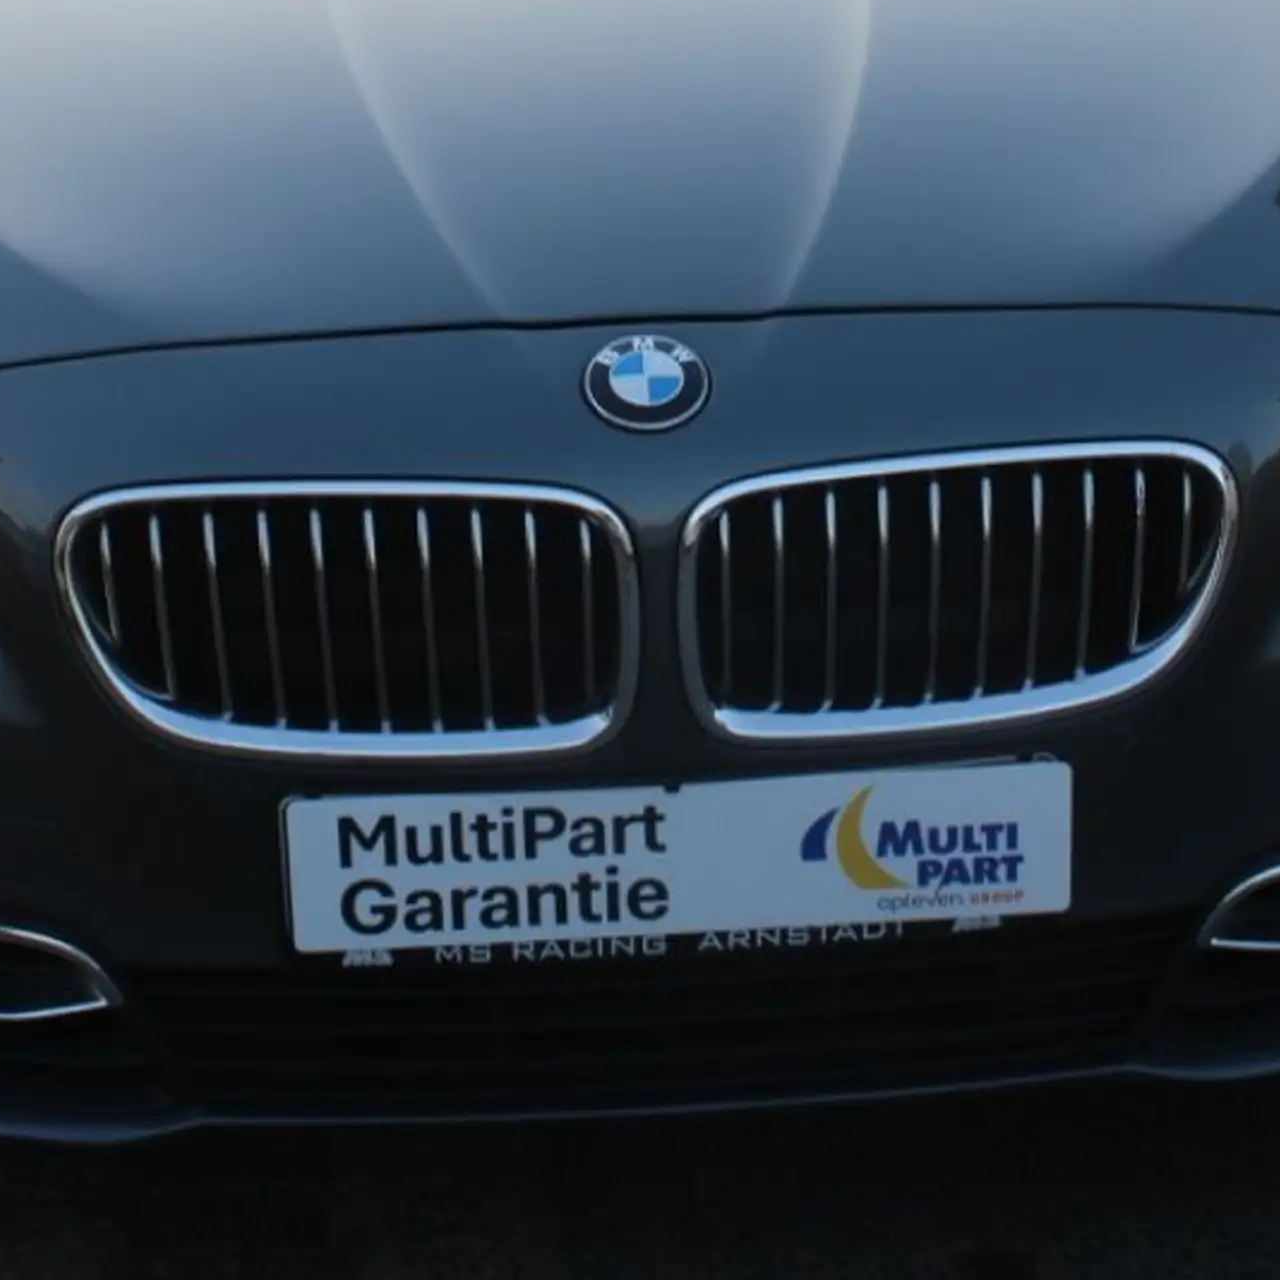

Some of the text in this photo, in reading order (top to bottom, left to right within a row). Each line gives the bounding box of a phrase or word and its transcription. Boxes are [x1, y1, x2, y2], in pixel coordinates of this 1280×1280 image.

[337, 805, 667, 869] MultiPart
[916, 853, 1024, 888] PART
[340, 865, 670, 935] Garantie
[434, 920, 904, 964] MS RACING ARNSTADT
